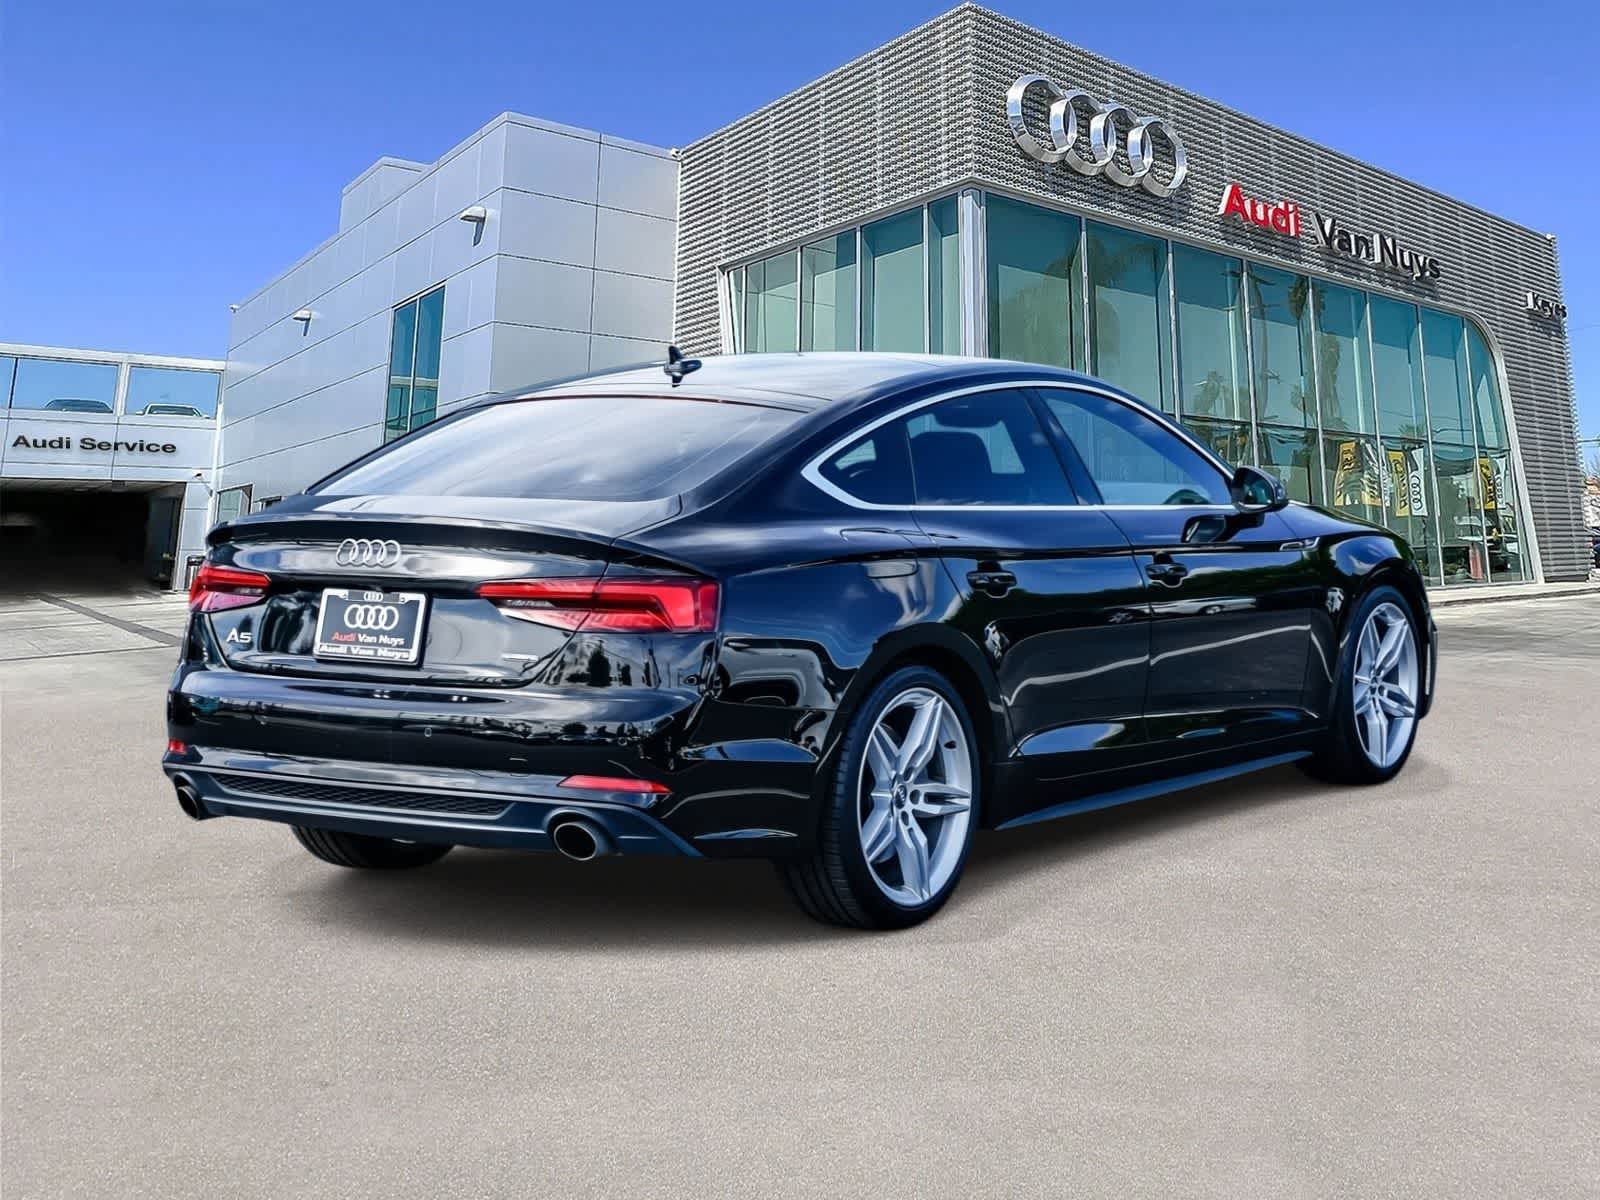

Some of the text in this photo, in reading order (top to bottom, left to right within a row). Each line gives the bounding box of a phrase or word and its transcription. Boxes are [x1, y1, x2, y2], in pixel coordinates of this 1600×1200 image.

[1218, 183, 1442, 281] Audi Van Nuys
[1526, 291, 1568, 319] Keyes
[12, 434, 177, 454] Audi Service
[226, 627, 252, 643] A5
[331, 632, 405, 646] Audi Van Nuys
[319, 644, 347, 654] Audi
[351, 646, 375, 656] Van
